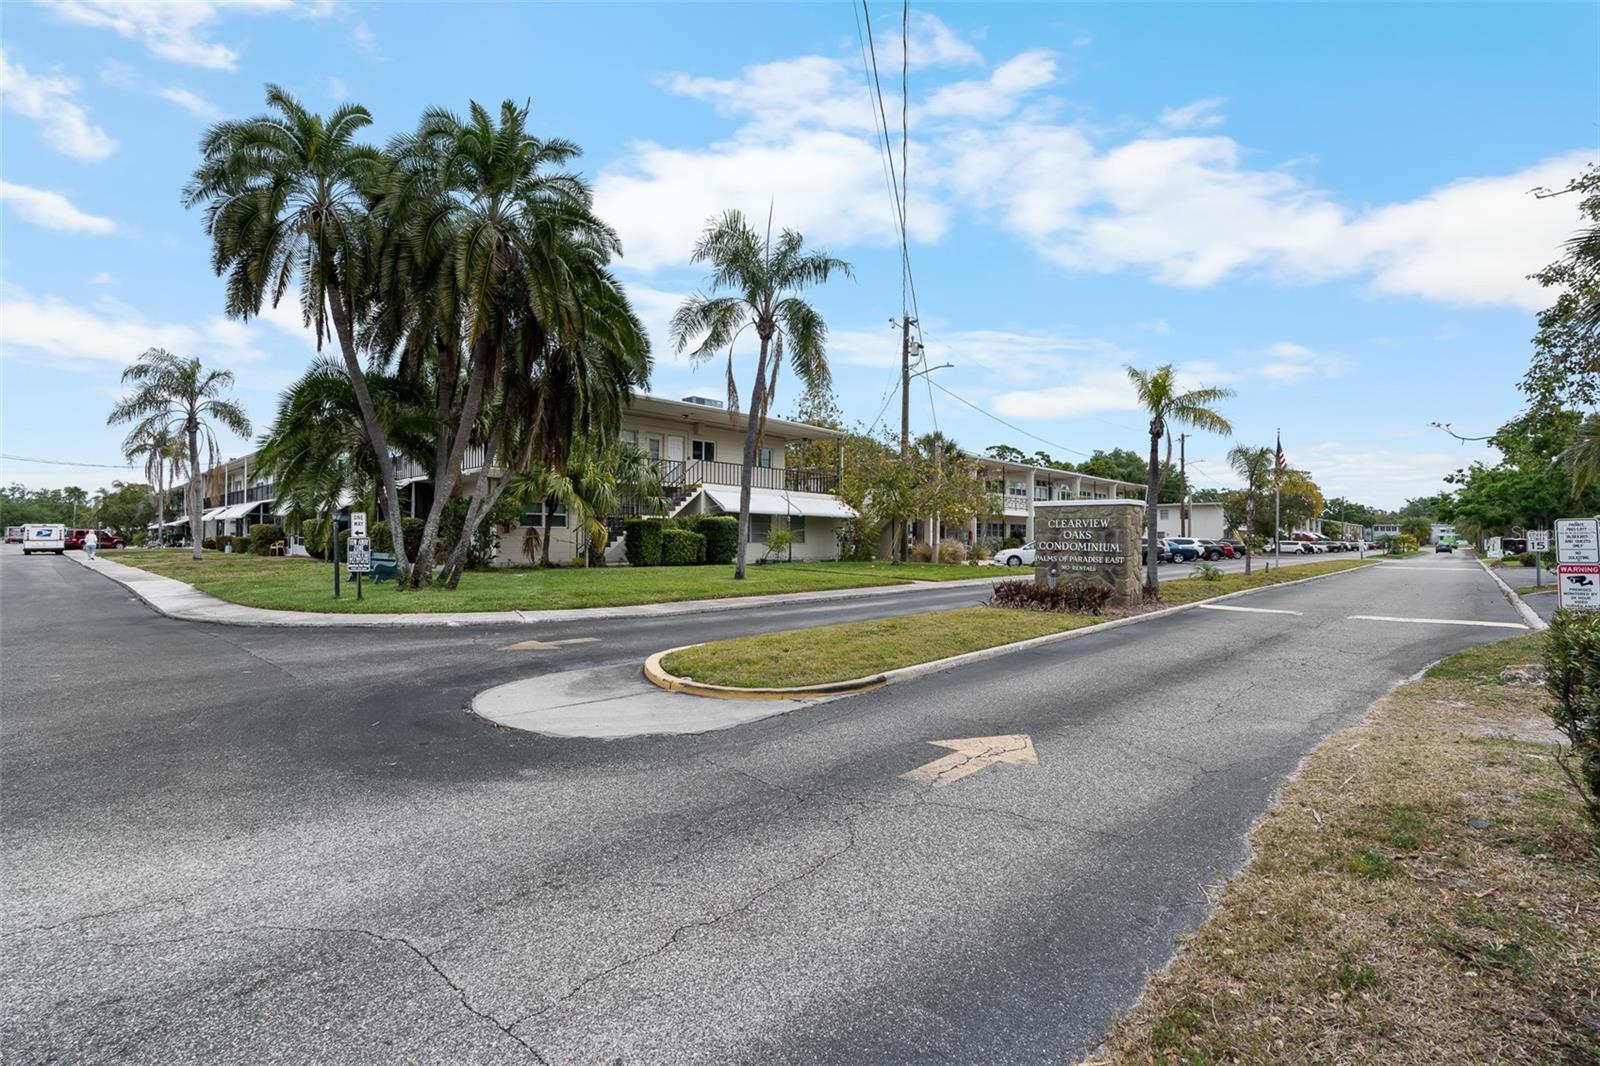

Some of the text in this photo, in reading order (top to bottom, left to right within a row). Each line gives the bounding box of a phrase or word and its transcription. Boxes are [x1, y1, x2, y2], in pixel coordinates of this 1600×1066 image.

[1048, 518, 1110, 528] CLEARVIEW
[1064, 530, 1092, 539] OAKS
[1039, 541, 1122, 552] CONDOMINIUM
[1531, 542, 1545, 550] 15
